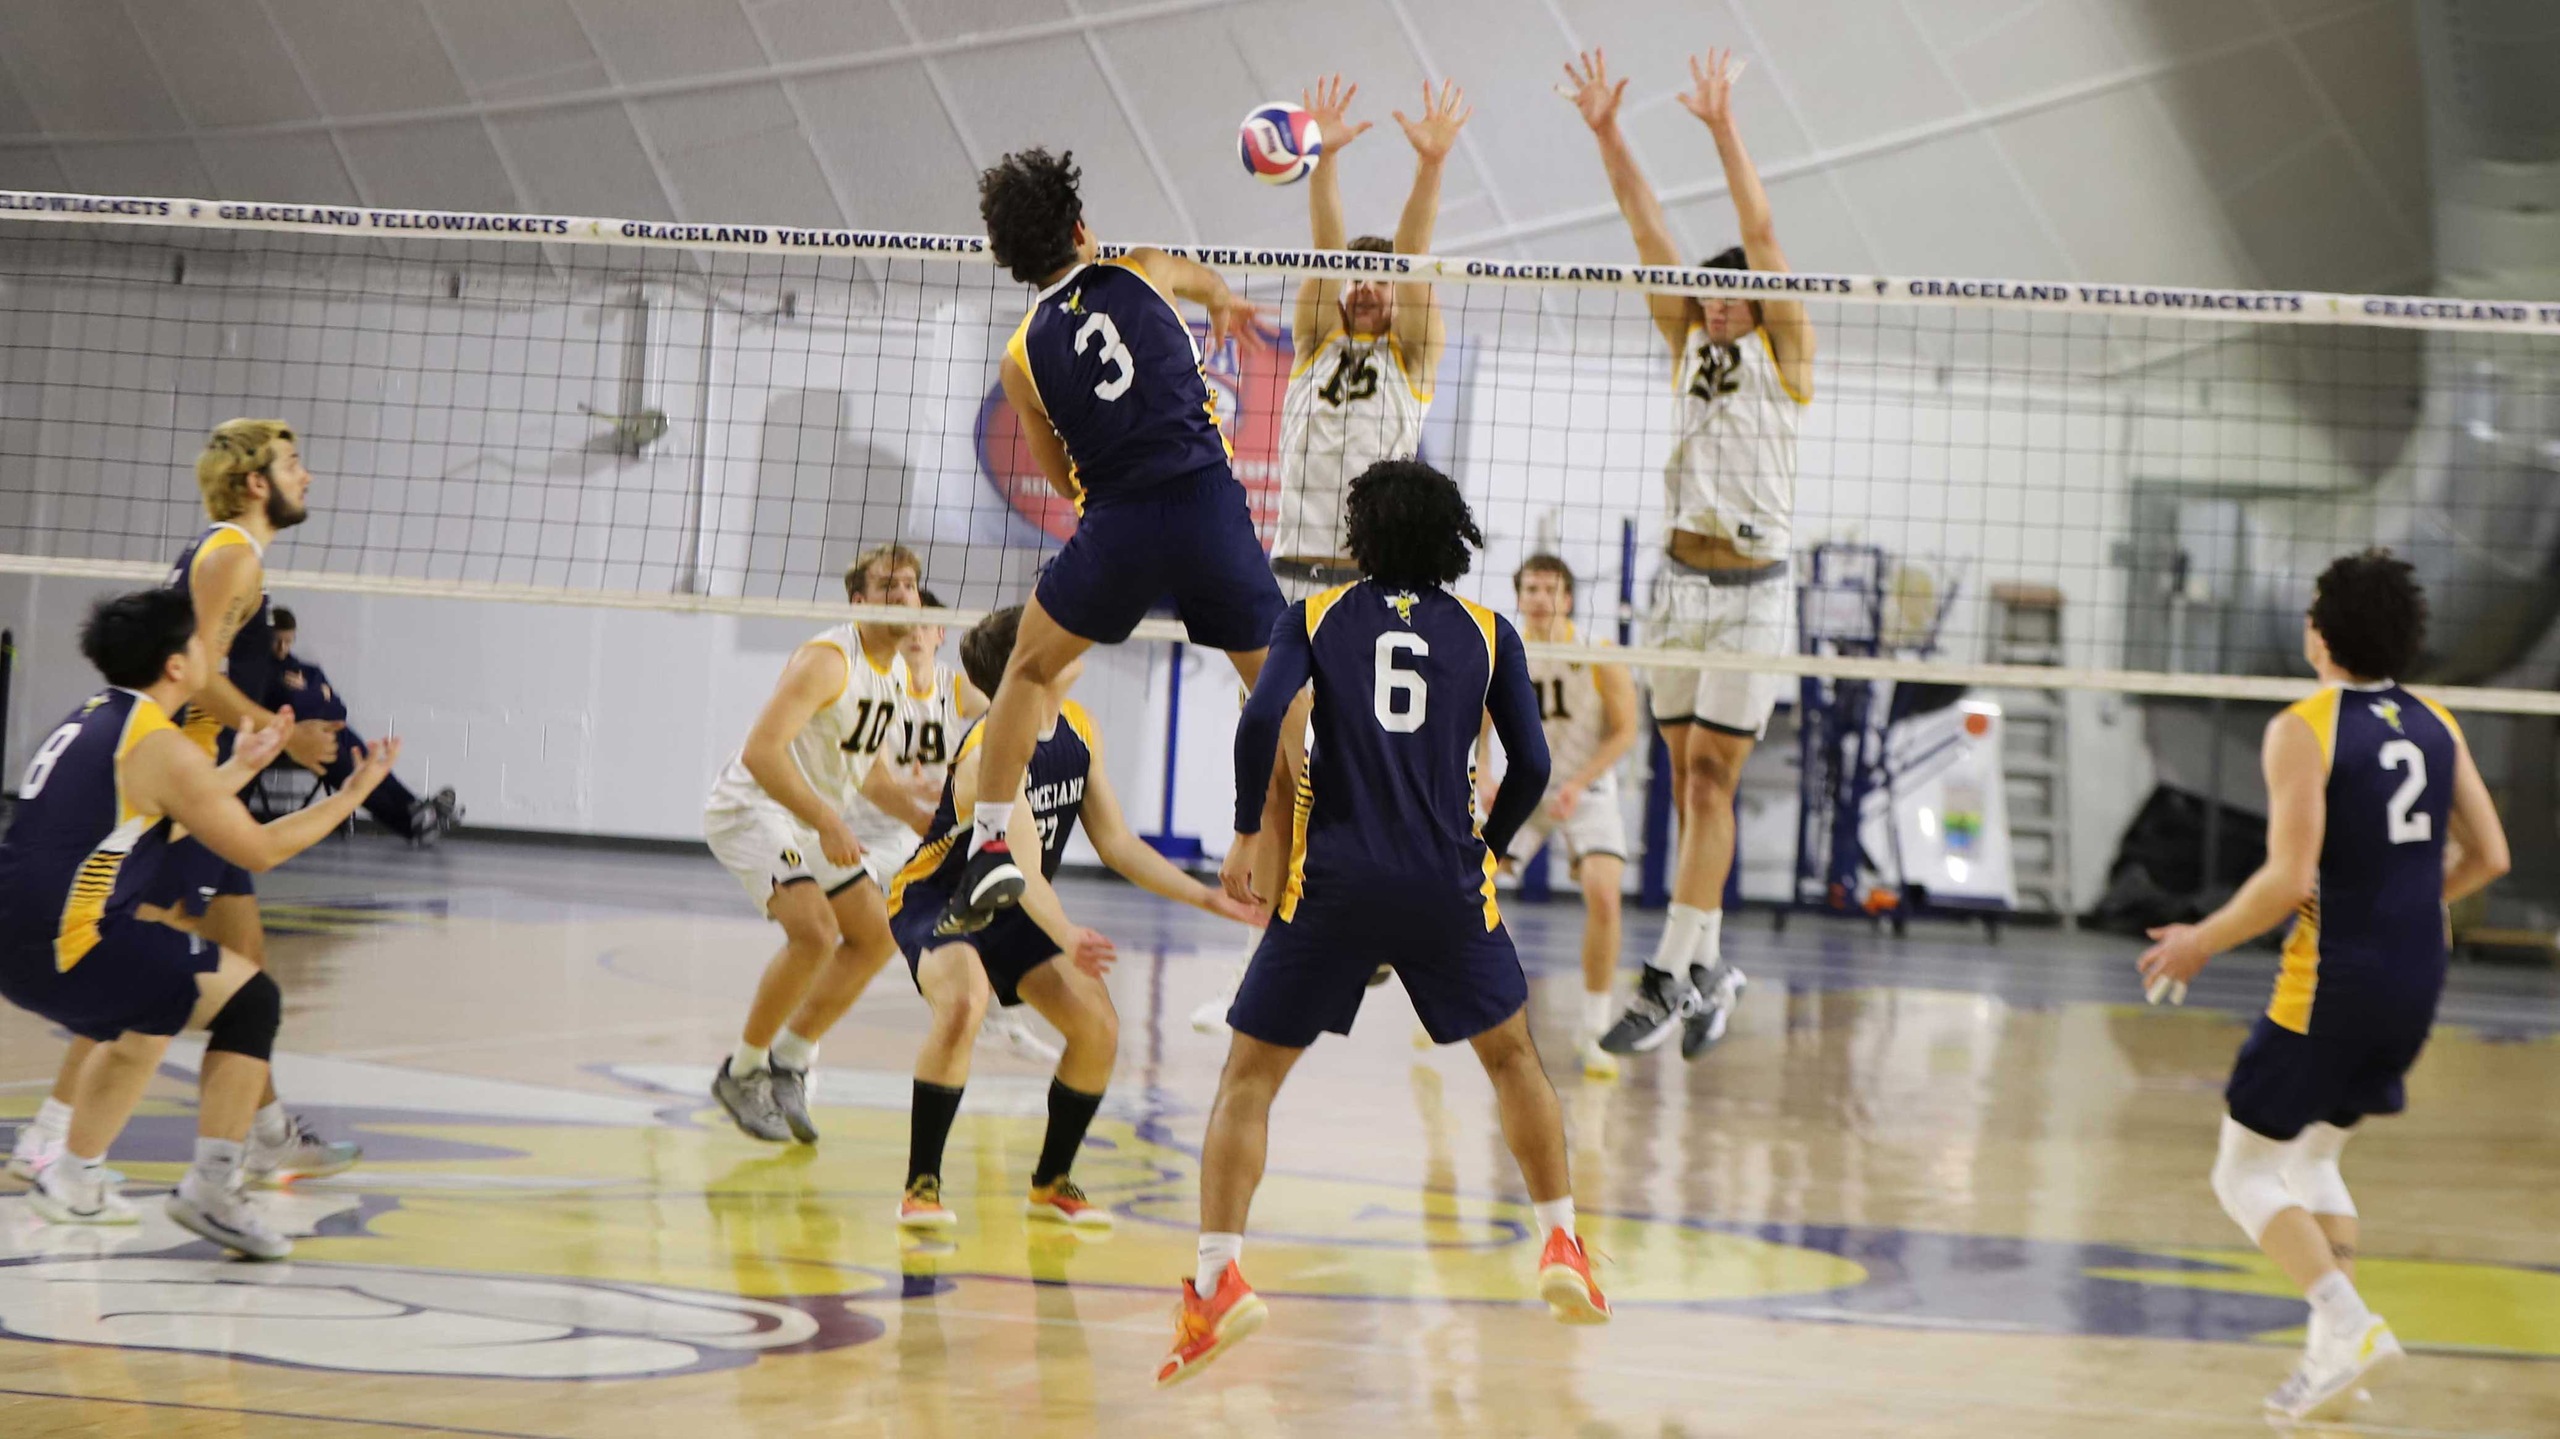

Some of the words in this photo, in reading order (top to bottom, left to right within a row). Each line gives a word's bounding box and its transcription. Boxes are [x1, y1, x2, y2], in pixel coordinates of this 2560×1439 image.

[0, 194, 170, 216] LLOWJACKETS
[218, 205, 361, 226] GRACELAND
[370, 212, 569, 235] YELLOWJACKETS
[621, 222, 769, 244] GRACELAND
[777, 229, 984, 254] YELLOWJACKETS
[1196, 248, 1411, 274] YELLOWJACKETS
[1466, 261, 1623, 282] GRACELAND
[1632, 269, 1853, 294] YELLOWJACKETS
[1909, 281, 2069, 301] GRACELAND
[2079, 287, 2302, 312] YELLOWJACKETS
[2363, 300, 2527, 321] GRACELAND
[1074, 312, 1135, 402] 3
[1318, 348, 1378, 408] 15
[1373, 630, 1430, 734] 6
[840, 698, 895, 754] 10
[896, 720, 946, 765] 19
[18, 722, 84, 800] 8
[2378, 738, 2432, 845] 2
